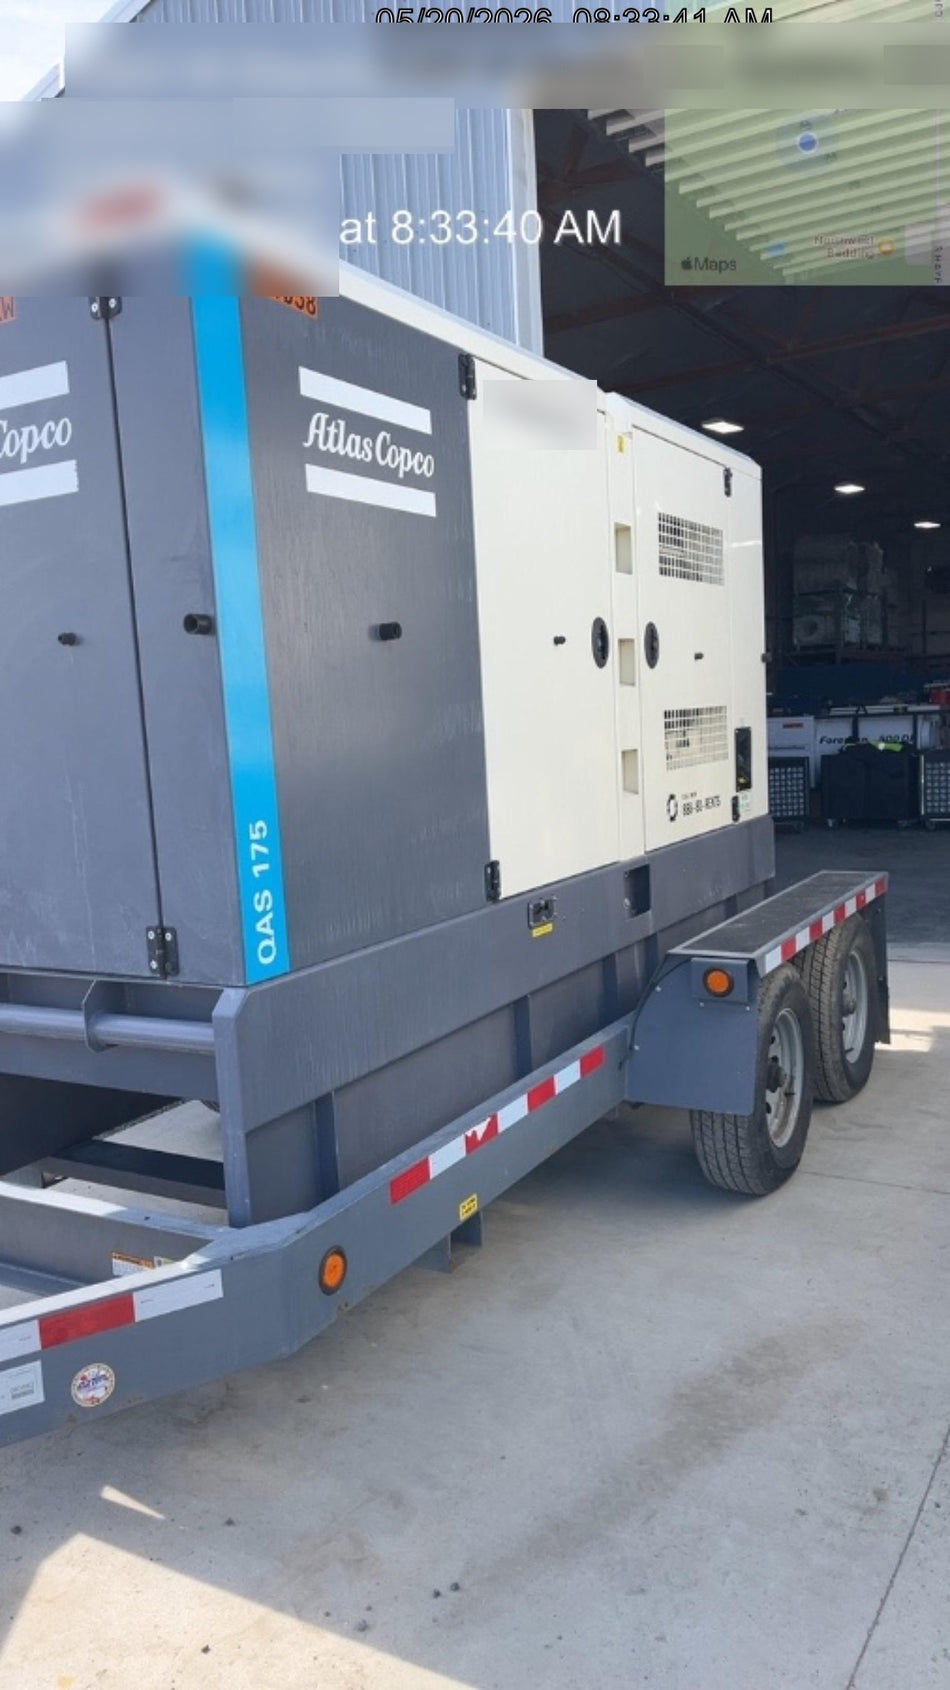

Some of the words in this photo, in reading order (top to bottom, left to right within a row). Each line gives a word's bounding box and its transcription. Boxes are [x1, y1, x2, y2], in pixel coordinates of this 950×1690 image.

[303, 412, 373, 463] Atlas
[375, 431, 435, 479] Copco
[249, 819, 270, 878] 175
[253, 889, 277, 965] QAS
